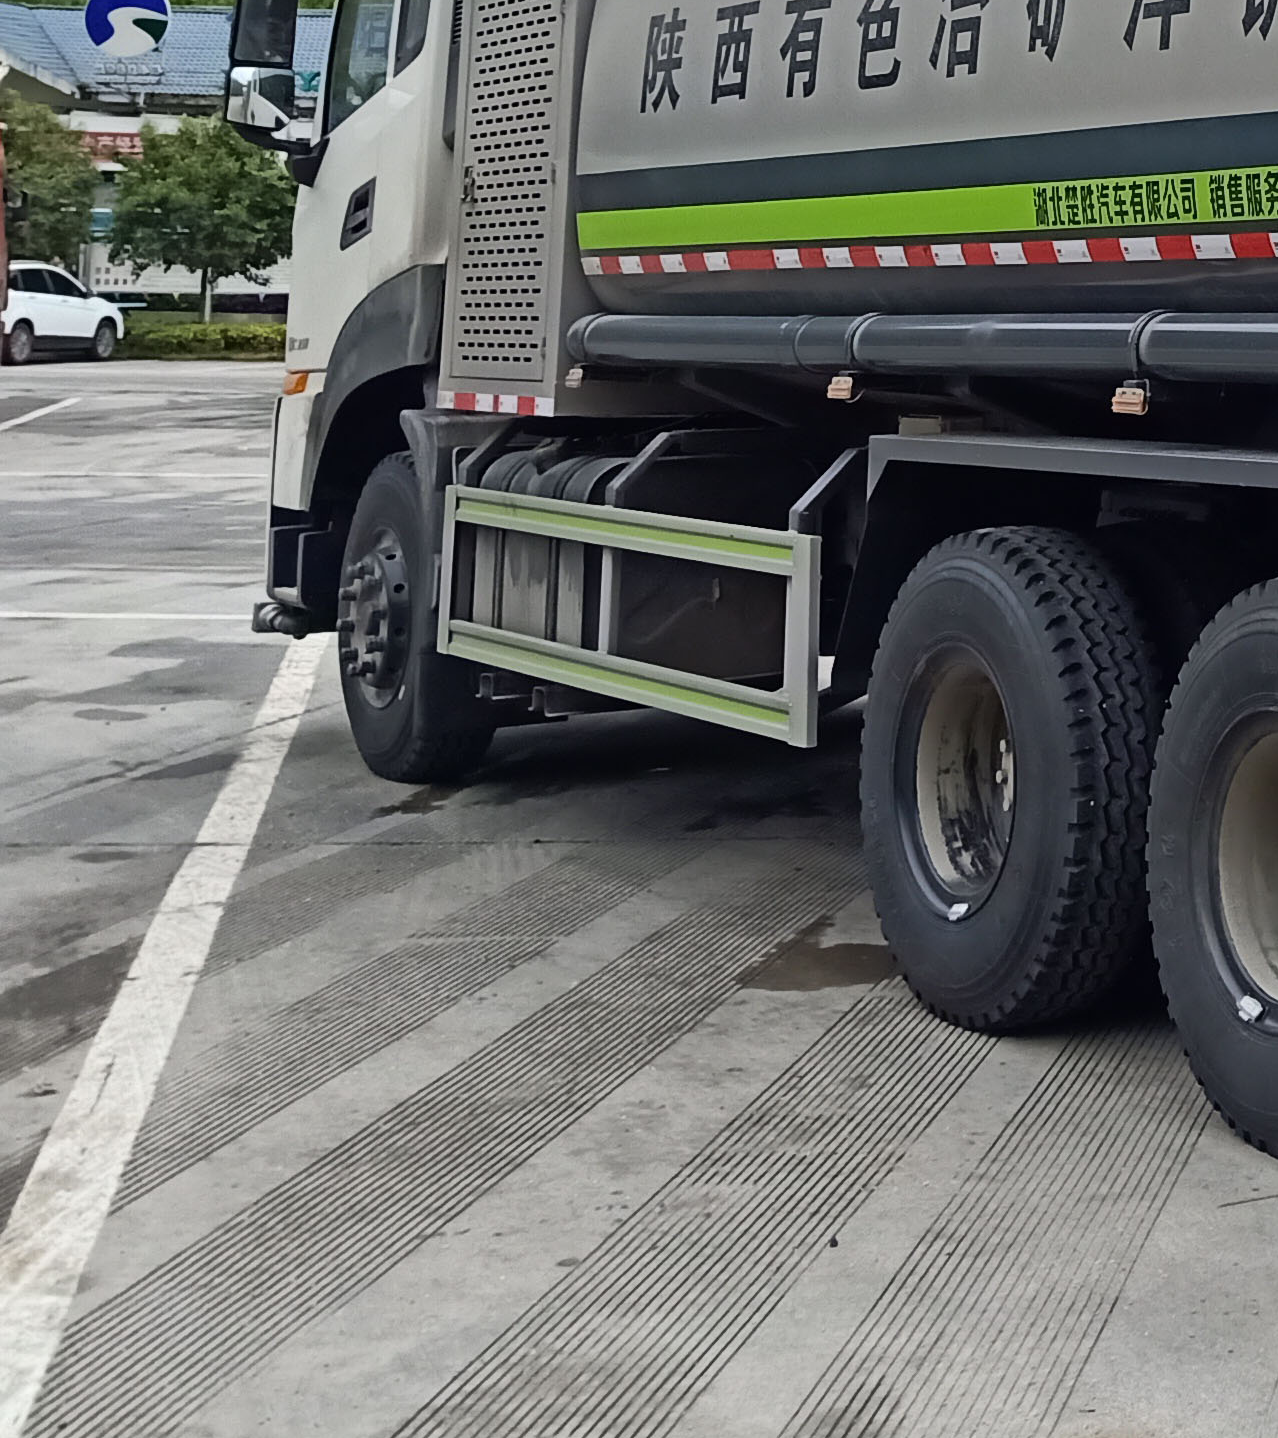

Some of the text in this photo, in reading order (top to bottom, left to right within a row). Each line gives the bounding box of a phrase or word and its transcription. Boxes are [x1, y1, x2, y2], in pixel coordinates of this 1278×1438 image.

[1032, 177, 1199, 227] 湖北楚胜汽车有限公司
